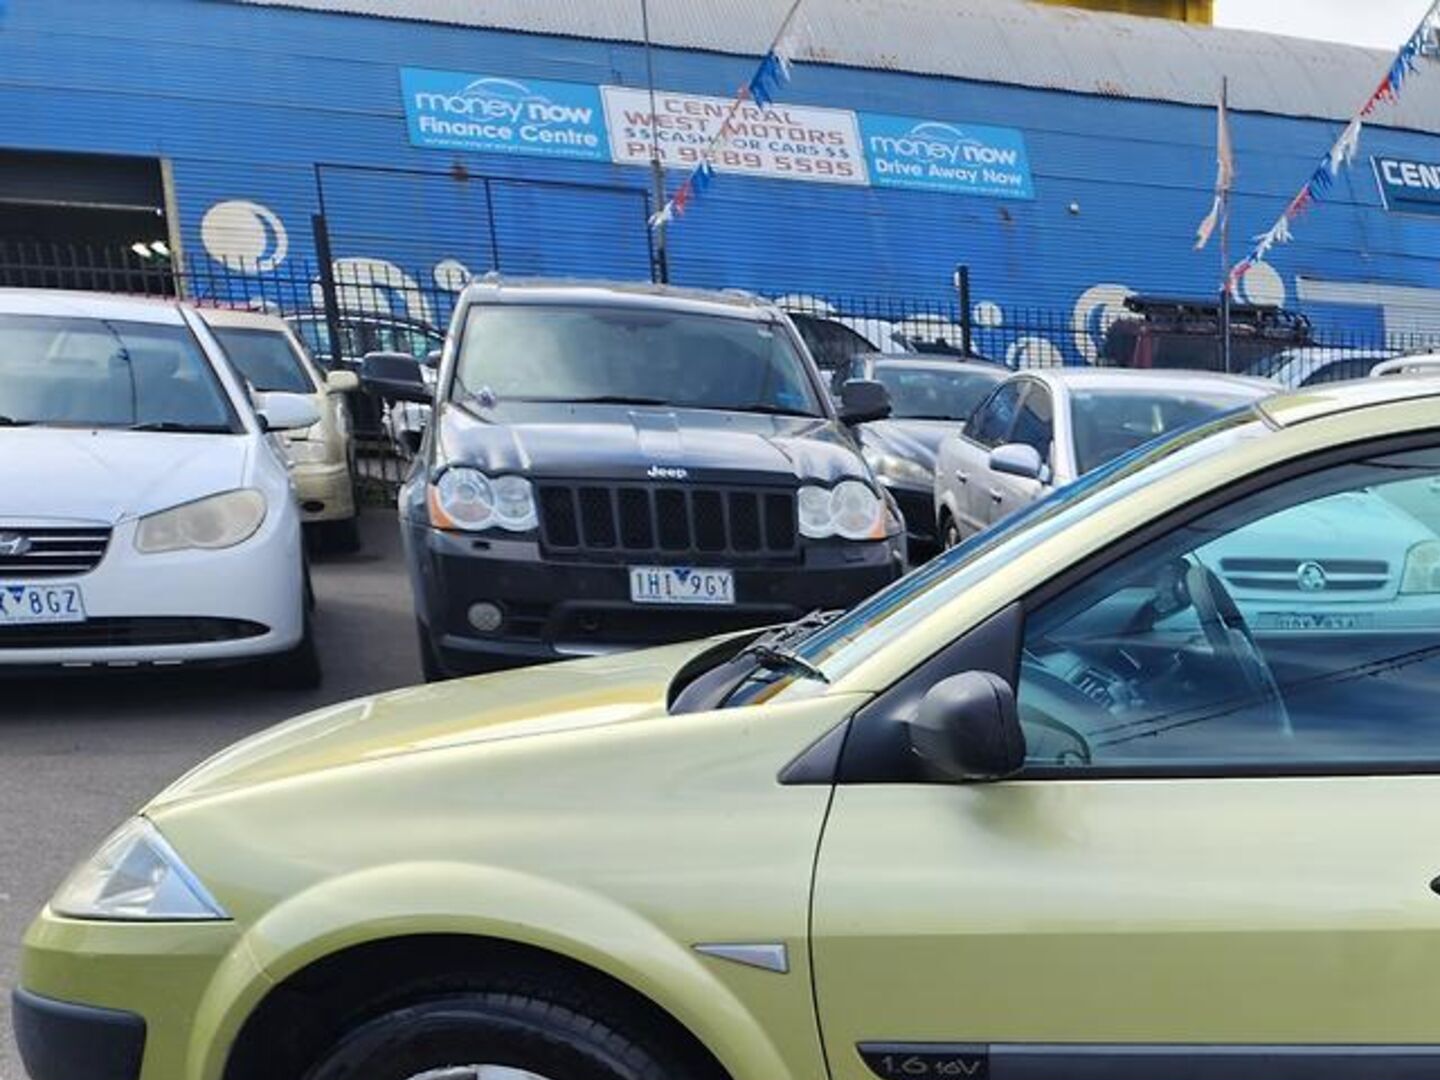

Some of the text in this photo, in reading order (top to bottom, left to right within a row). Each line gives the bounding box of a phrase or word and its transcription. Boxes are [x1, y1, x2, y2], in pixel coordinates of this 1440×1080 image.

[415, 92, 592, 125] money now
[664, 99, 801, 126] CENTRAL
[418, 115, 512, 141] Finance
[519, 124, 598, 148] Centre
[624, 110, 845, 146] WEST MOTORS
[625, 141, 667, 161] Ph
[775, 155, 854, 177] 5595
[768, 140, 821, 156] CARS
[870, 136, 1017, 167] money now
[875, 158, 922, 176] Drive
[929, 163, 977, 184] Away
[983, 170, 1022, 187] Now
[647, 465, 688, 479] Jeep
[881, 1055, 981, 1076] 1.6 16V
